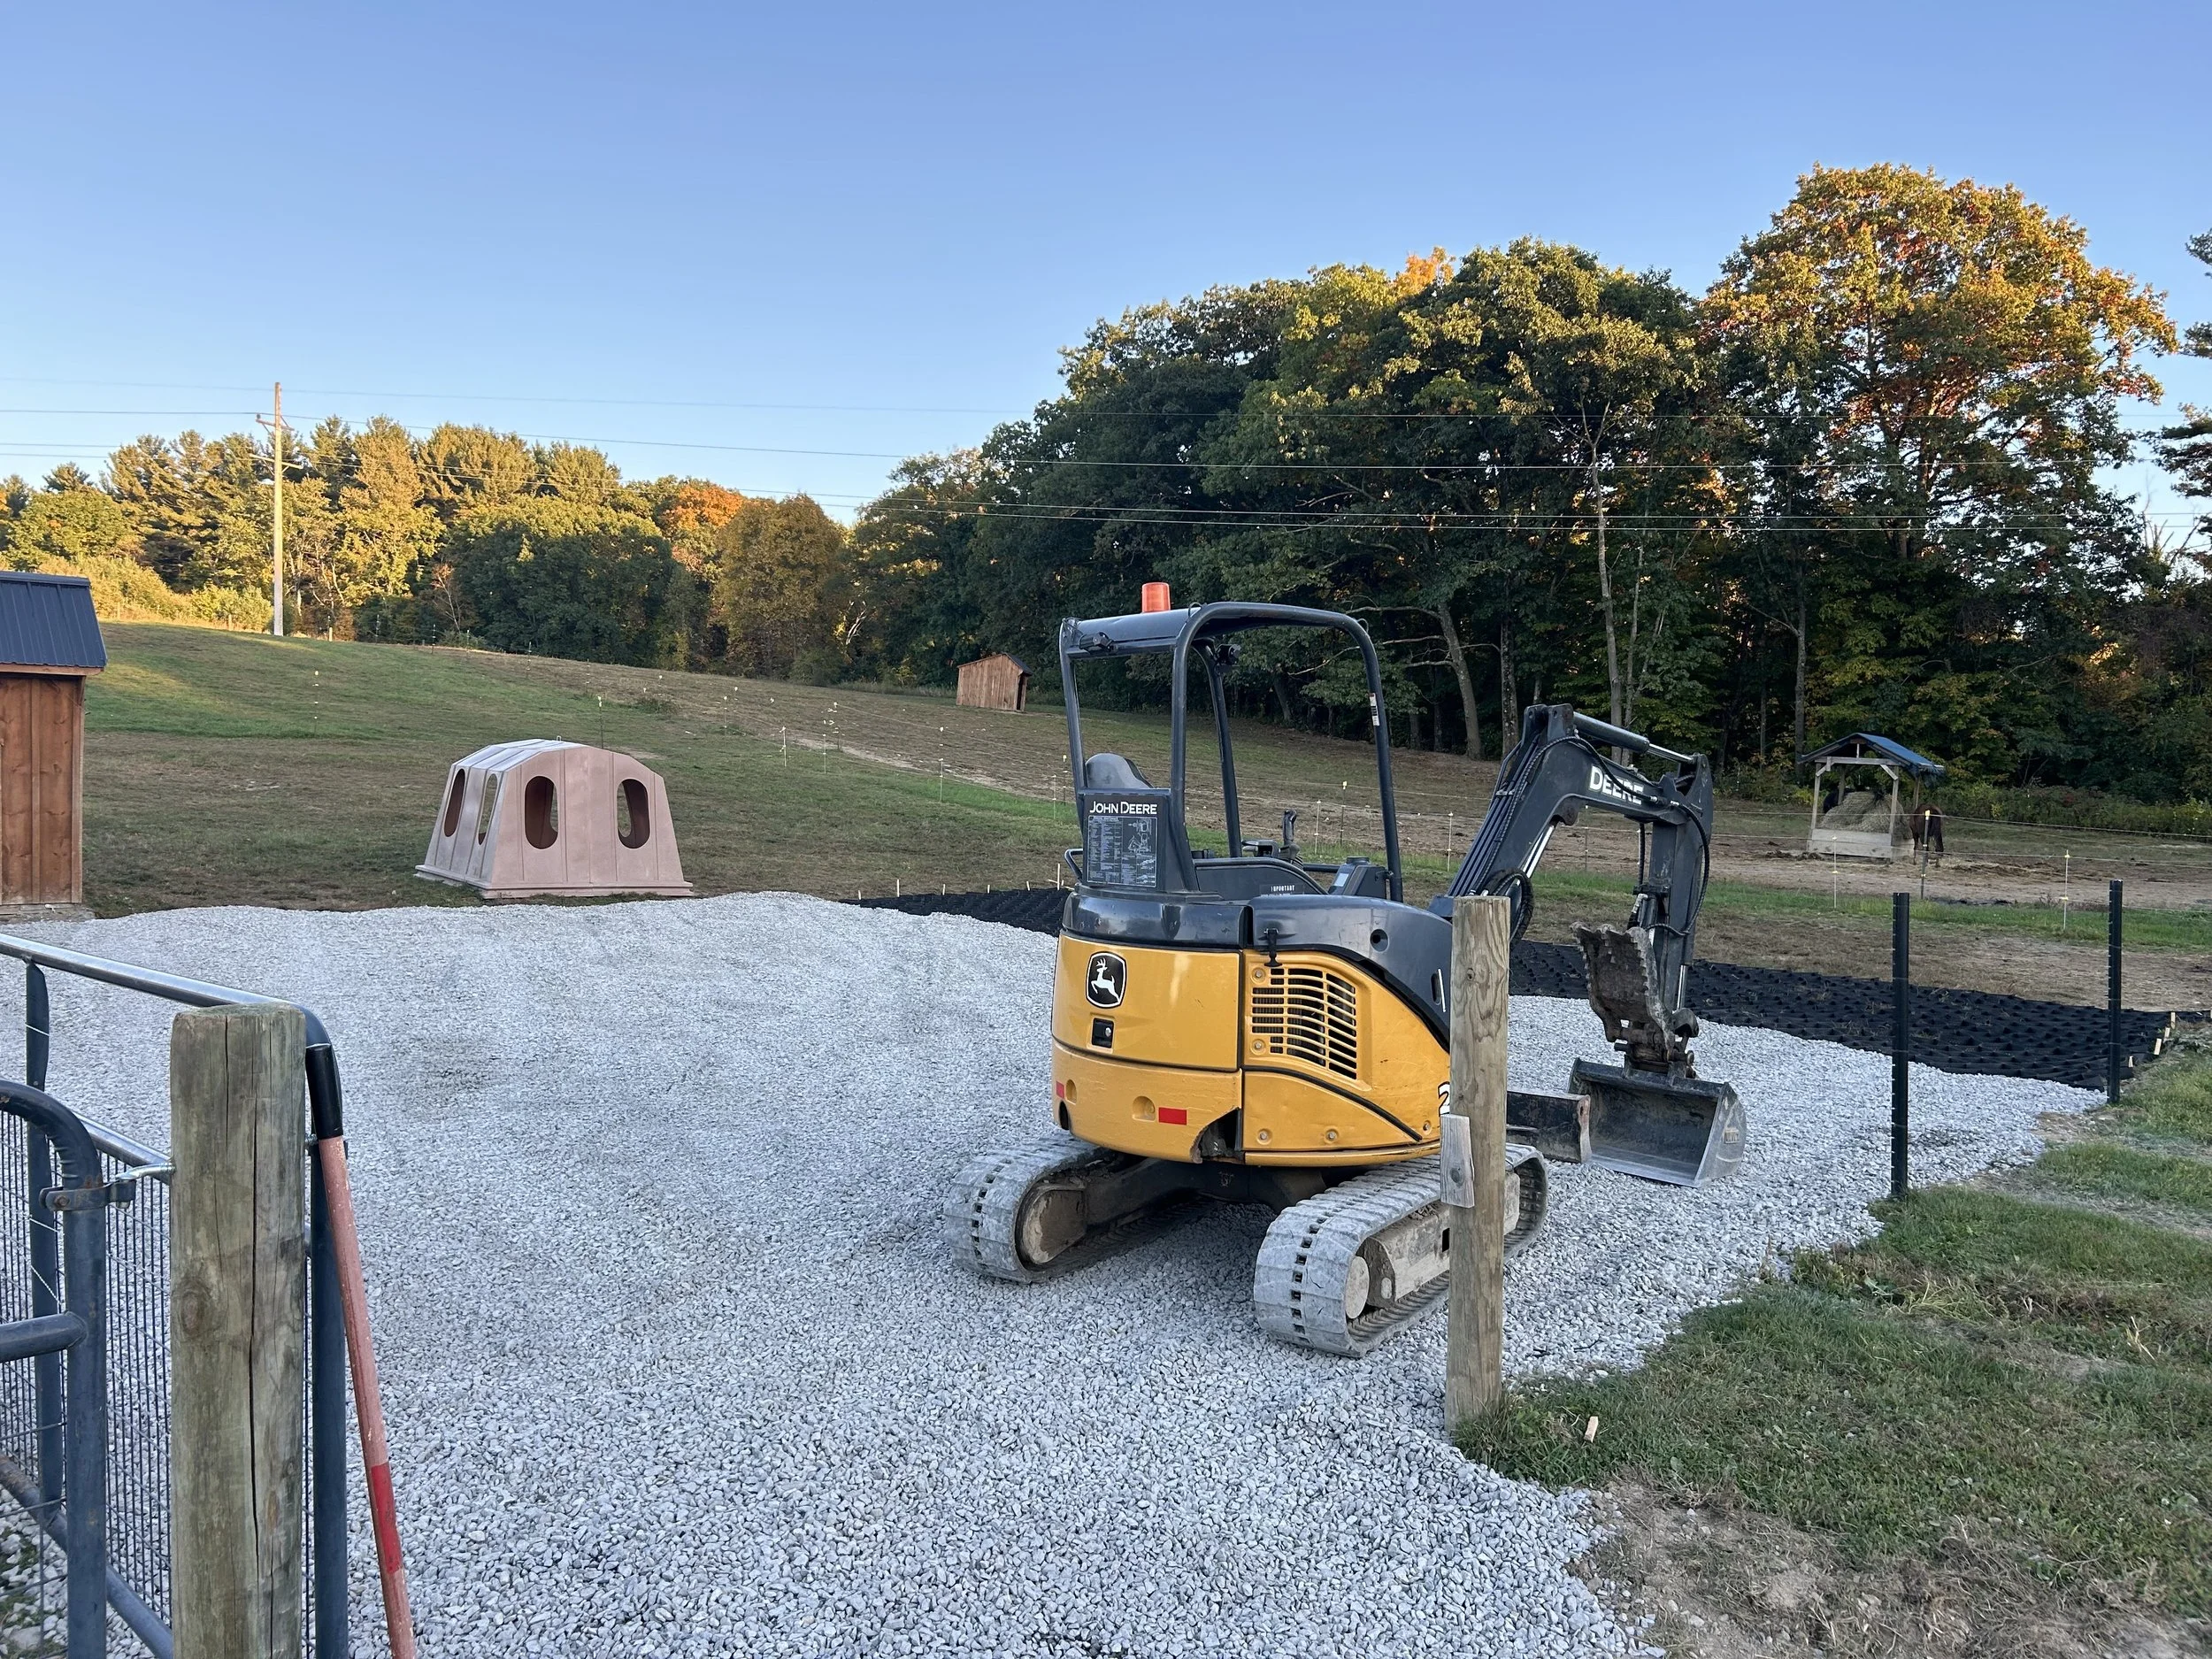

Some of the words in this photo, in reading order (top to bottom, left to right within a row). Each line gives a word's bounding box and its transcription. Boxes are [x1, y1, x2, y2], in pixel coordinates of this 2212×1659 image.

[1589, 765, 1644, 805] DEERE
[1089, 801, 1118, 814] JOHN
[1120, 801, 1157, 815] DEERE
